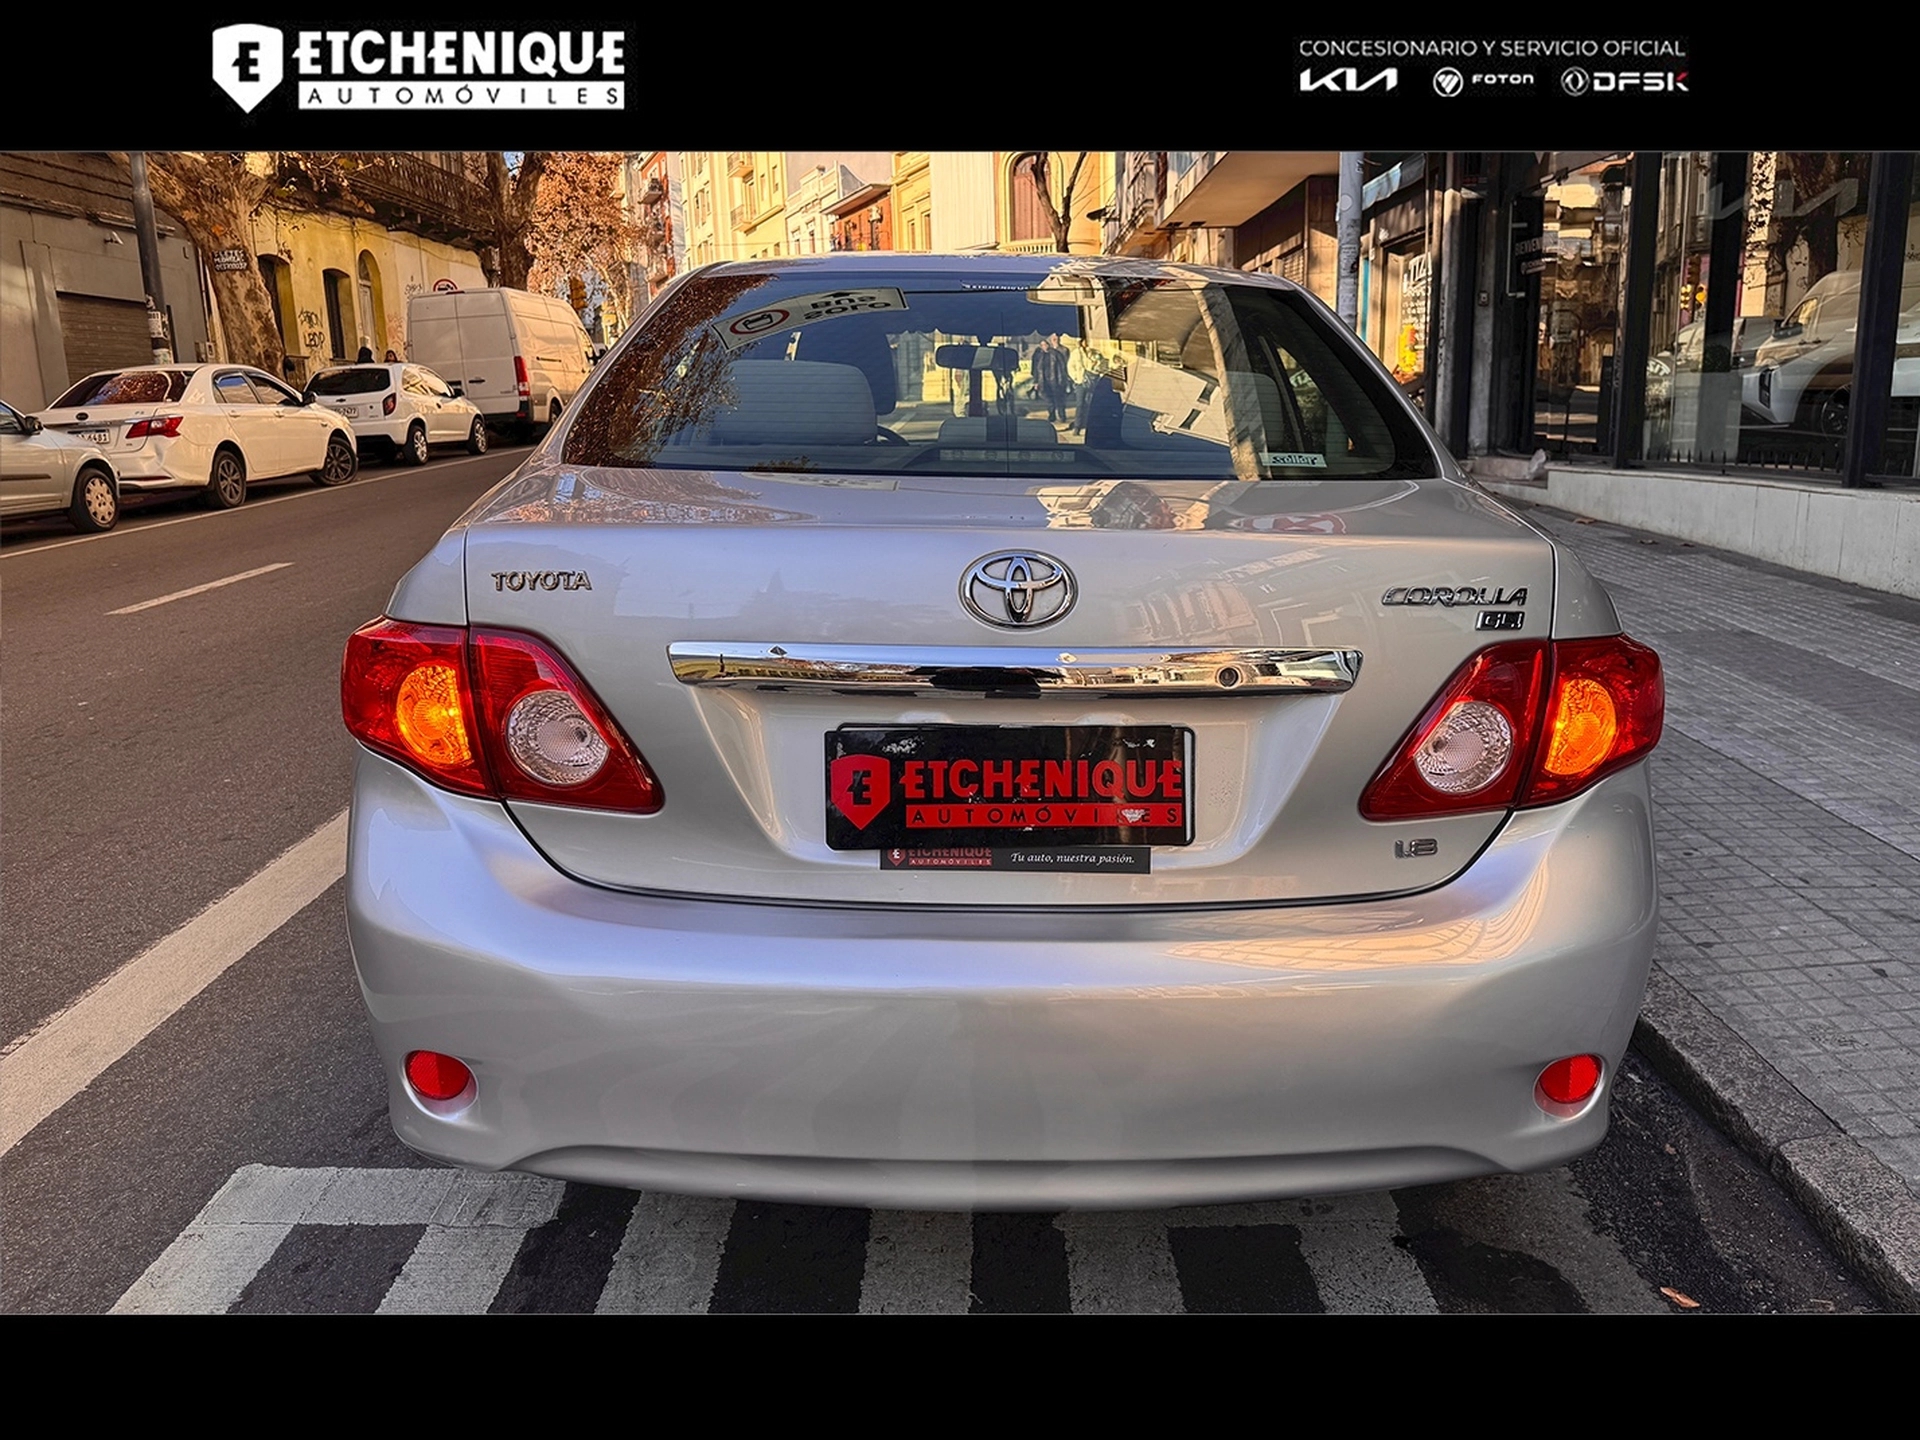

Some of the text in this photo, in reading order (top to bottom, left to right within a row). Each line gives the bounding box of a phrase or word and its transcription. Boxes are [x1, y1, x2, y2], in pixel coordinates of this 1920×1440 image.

[490, 570, 593, 592] TOYOTA
[1381, 586, 1529, 608] COROLLA
[899, 759, 1183, 800] ETCHENIQUE
[1010, 851, 1135, 866] Tu auto, nuestra pasión.
